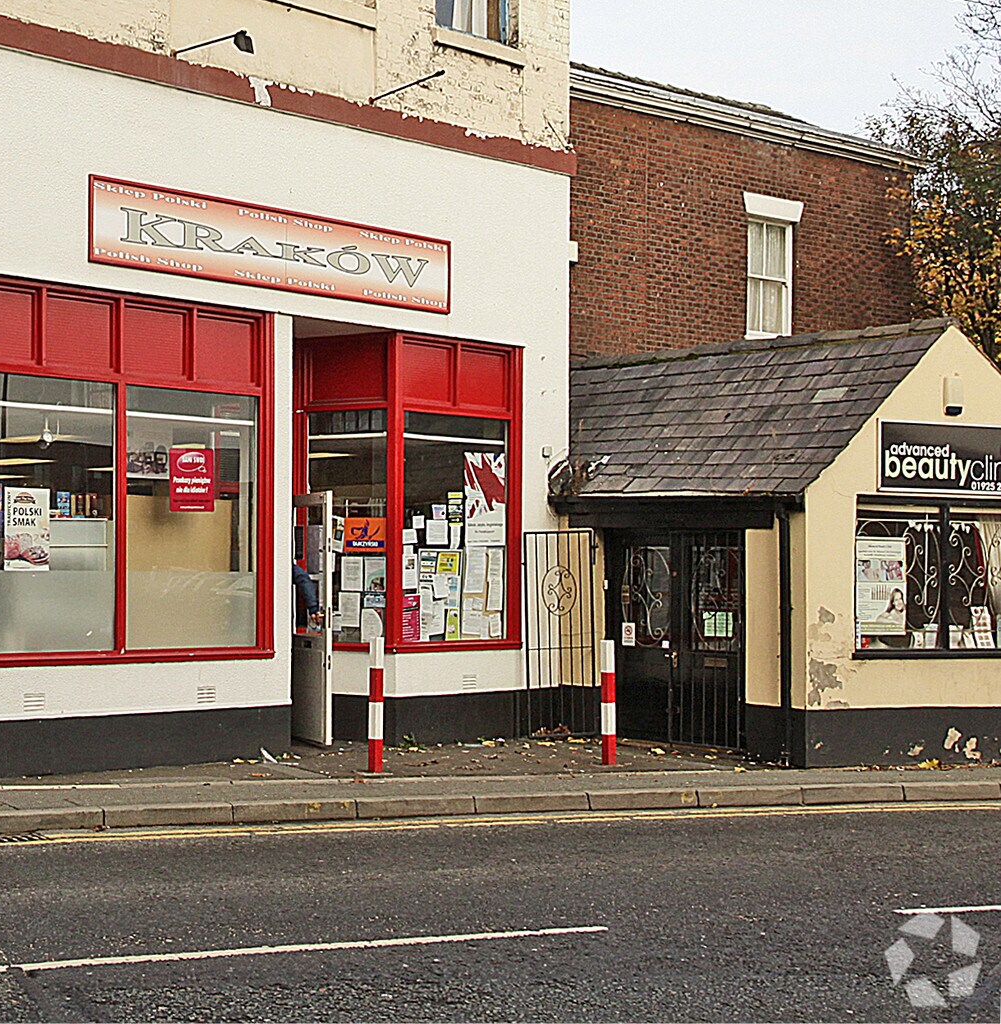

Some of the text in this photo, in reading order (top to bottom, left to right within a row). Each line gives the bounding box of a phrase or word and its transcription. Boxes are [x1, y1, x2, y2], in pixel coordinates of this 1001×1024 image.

[93, 181, 208, 209] Sklep Polski
[238, 208, 334, 233] Polish Shop
[119, 206, 429, 288] KRAKÓW
[359, 230, 447, 253] Sklep Polski
[93, 247, 204, 272] Polish Shop
[234, 269, 336, 291] Sklep Polski
[362, 288, 447, 309] Polish Shop
[890, 442, 950, 457] advanced
[970, 481, 996, 491] 01925
[12, 507, 42, 516] POLSKI
[12, 517, 37, 527] SMAK
